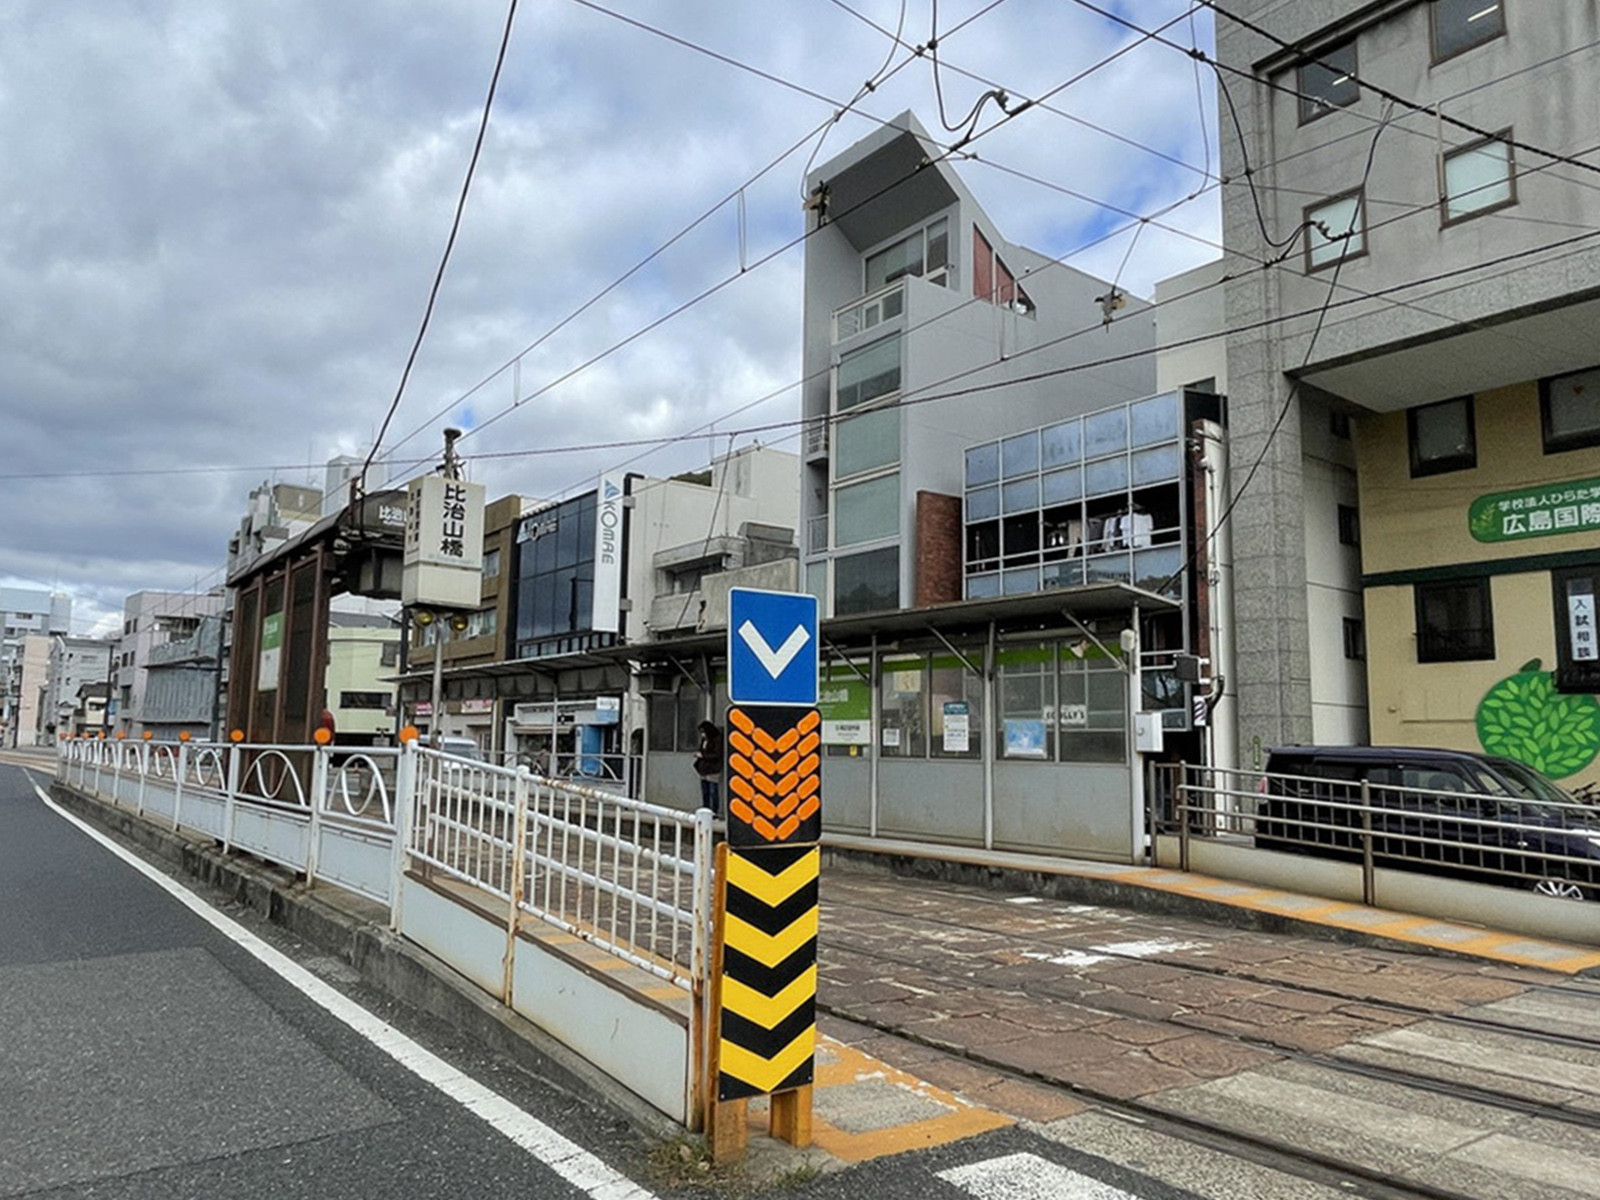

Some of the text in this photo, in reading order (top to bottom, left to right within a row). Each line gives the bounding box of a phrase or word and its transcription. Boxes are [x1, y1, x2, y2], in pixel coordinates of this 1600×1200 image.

[440, 483, 466, 558] 比治山橋
[600, 501, 618, 565] KOMAE
[1502, 502, 1600, 535] 広島国際
[1574, 598, 1591, 658] 入試相談
